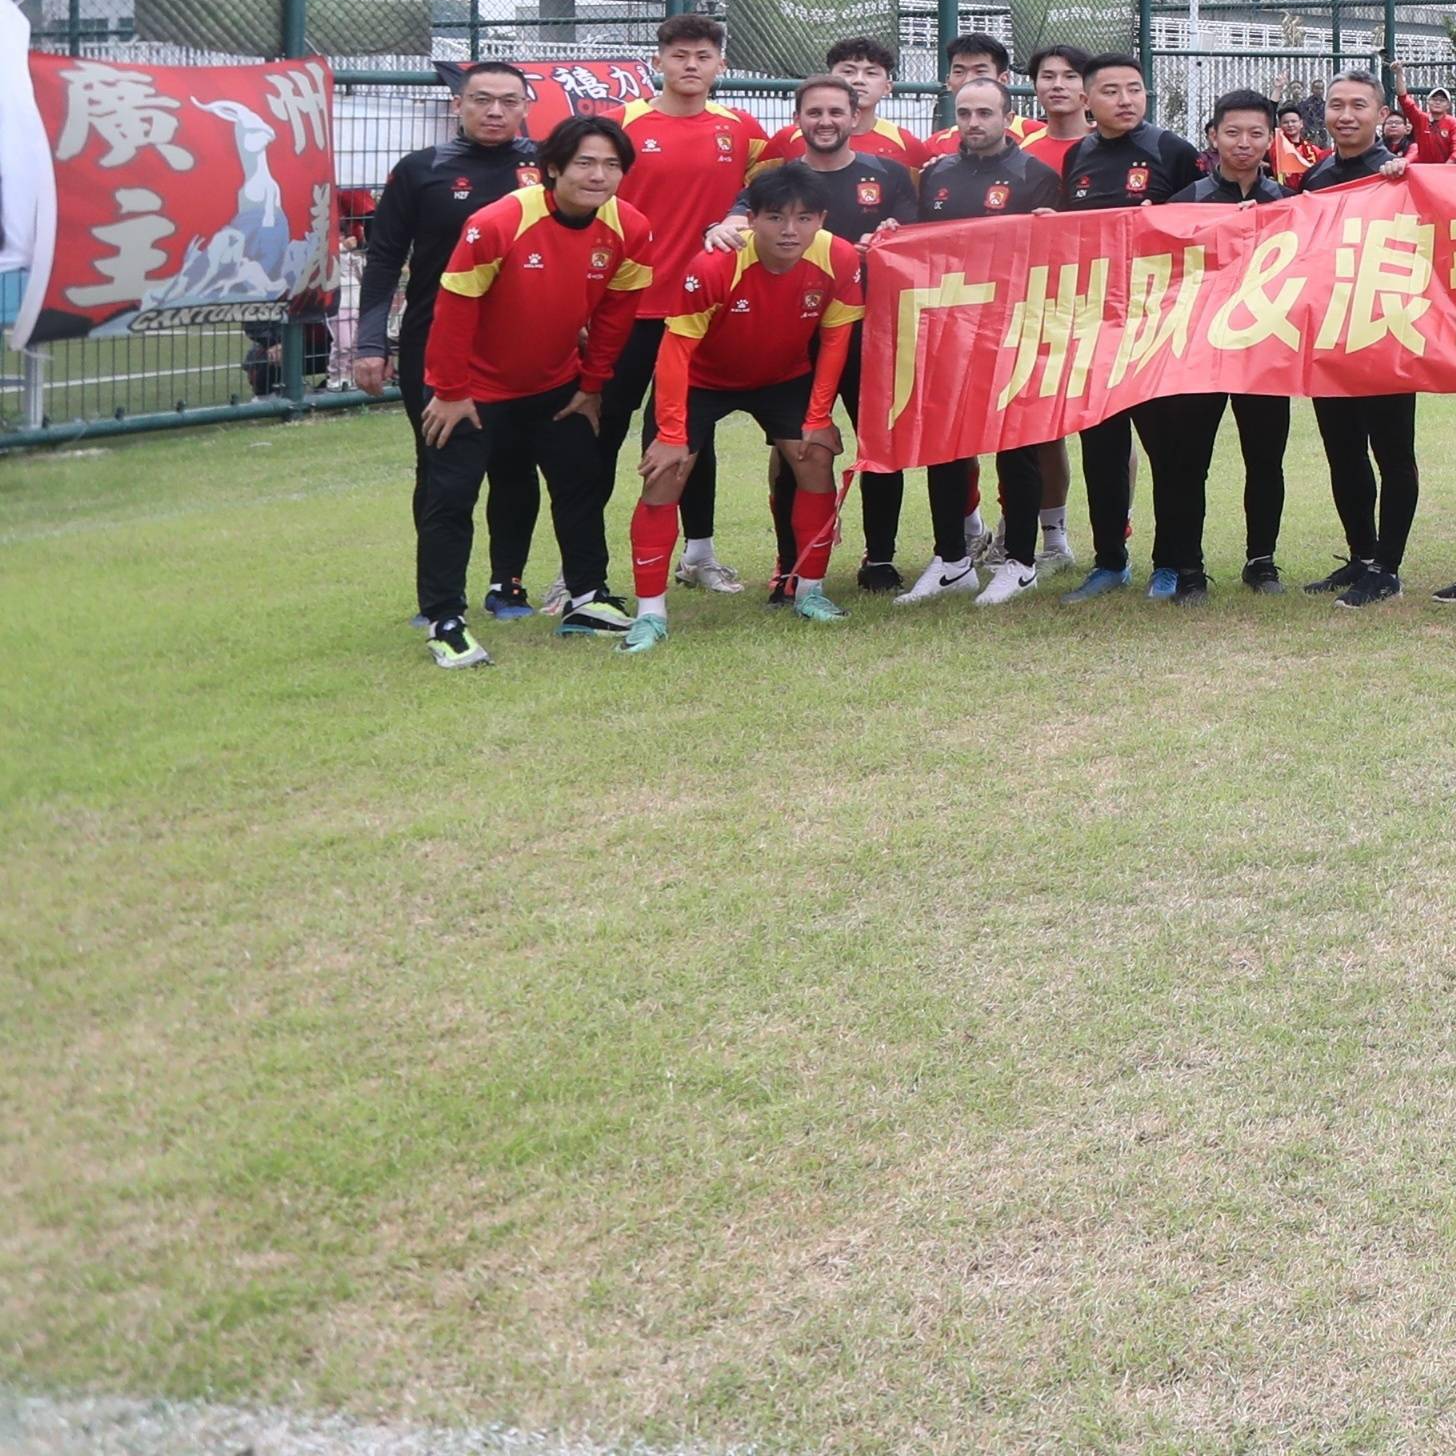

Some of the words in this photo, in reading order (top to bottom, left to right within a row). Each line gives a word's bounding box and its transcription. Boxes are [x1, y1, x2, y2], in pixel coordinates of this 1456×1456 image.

[56, 60, 195, 170] 廣
[65, 188, 176, 307] 主
[131, 301, 287, 331] CANTONESE
